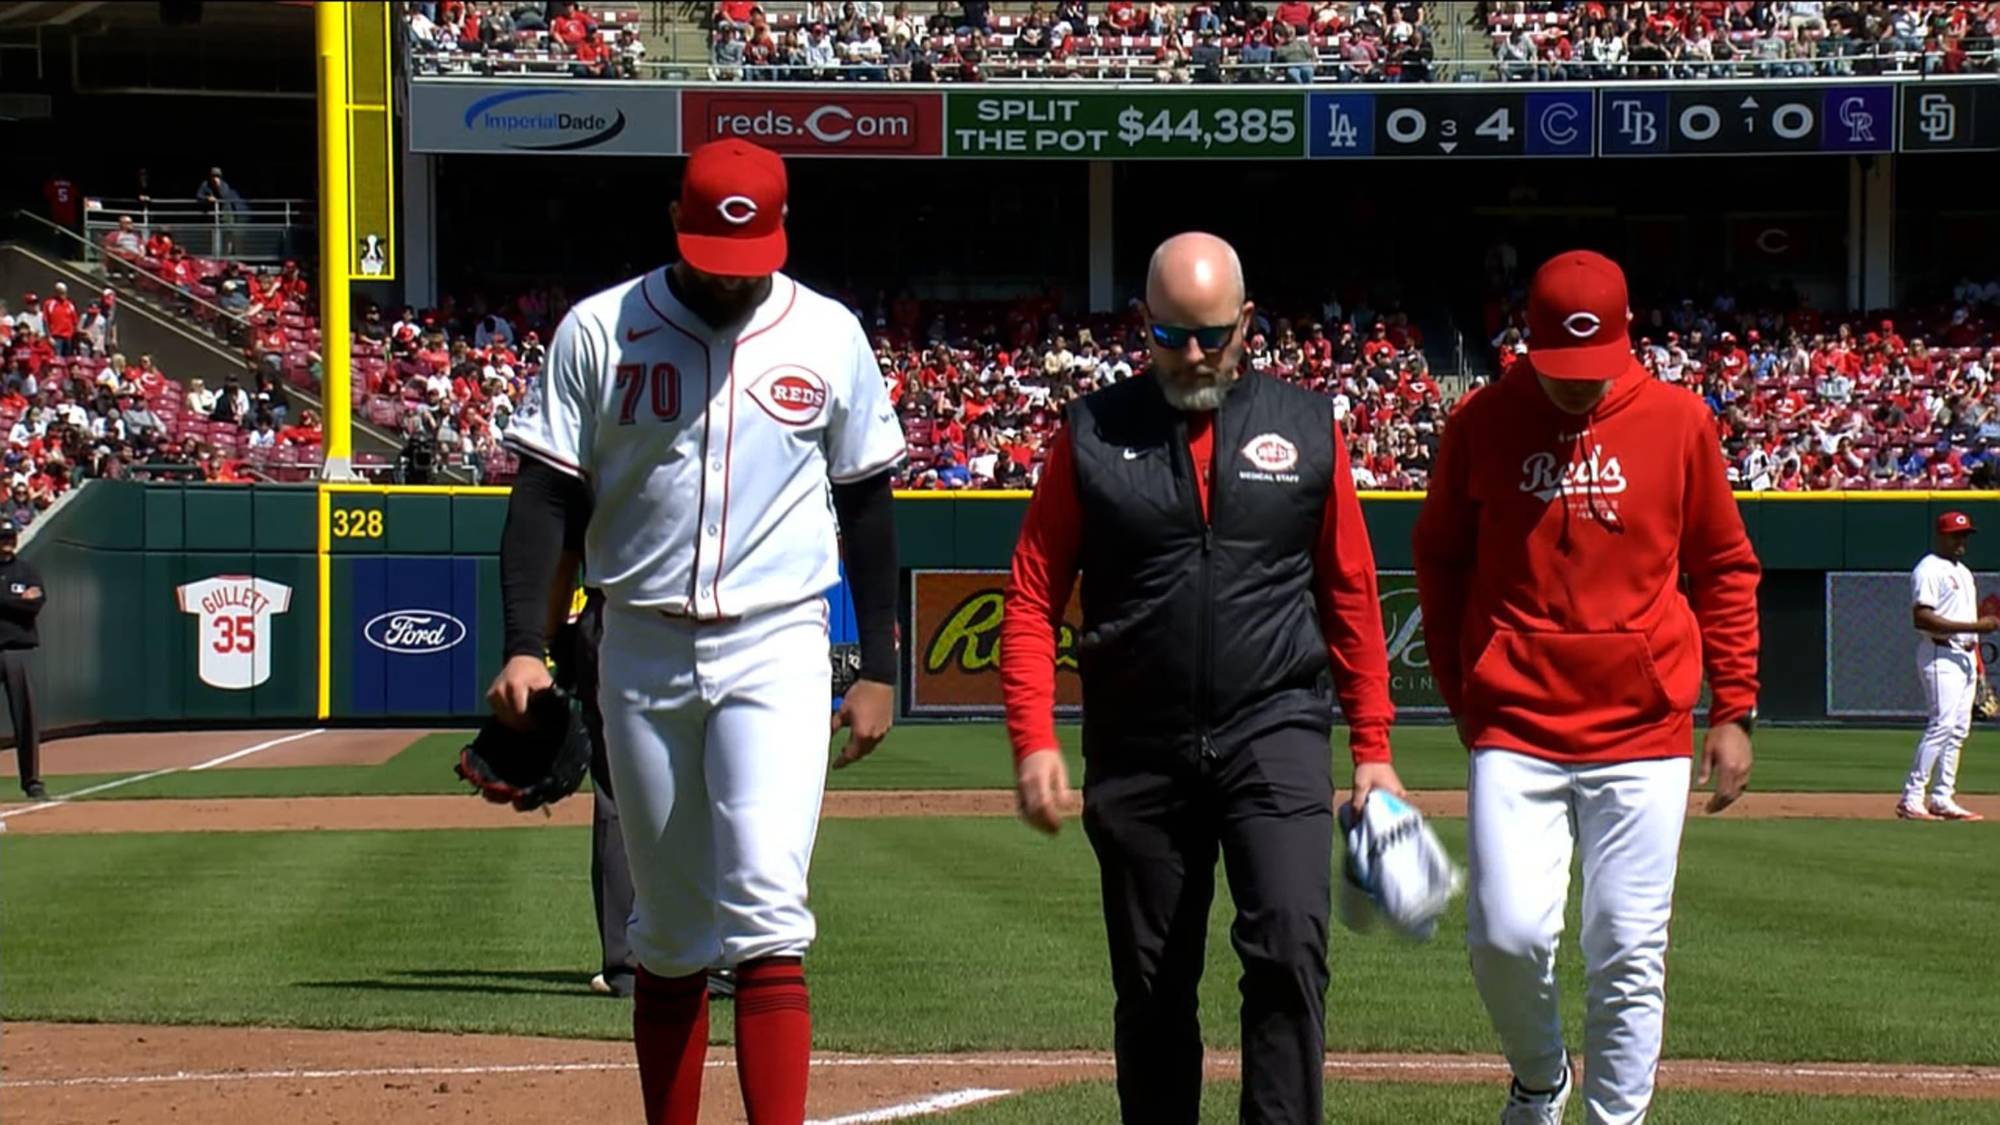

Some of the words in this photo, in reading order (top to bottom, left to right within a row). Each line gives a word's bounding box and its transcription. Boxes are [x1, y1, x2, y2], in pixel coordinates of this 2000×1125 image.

[977, 100, 1079, 121] SPLIT
[1475, 108, 1515, 142] 4
[1540, 102, 1578, 145] C
[1612, 100, 1657, 145] TB
[1744, 117, 1754, 134] 1
[955, 129, 1027, 151] THE
[1035, 129, 1108, 151] POT
[1117, 106, 1296, 149] $44,385
[1440, 120, 1457, 137] 3
[616, 363, 681, 426] 70
[771, 385, 826, 406] REDS
[332, 509, 384, 537] 328
[202, 586, 270, 615] GULLETT
[212, 616, 255, 653] 35
[383, 615, 446, 646] Ford
